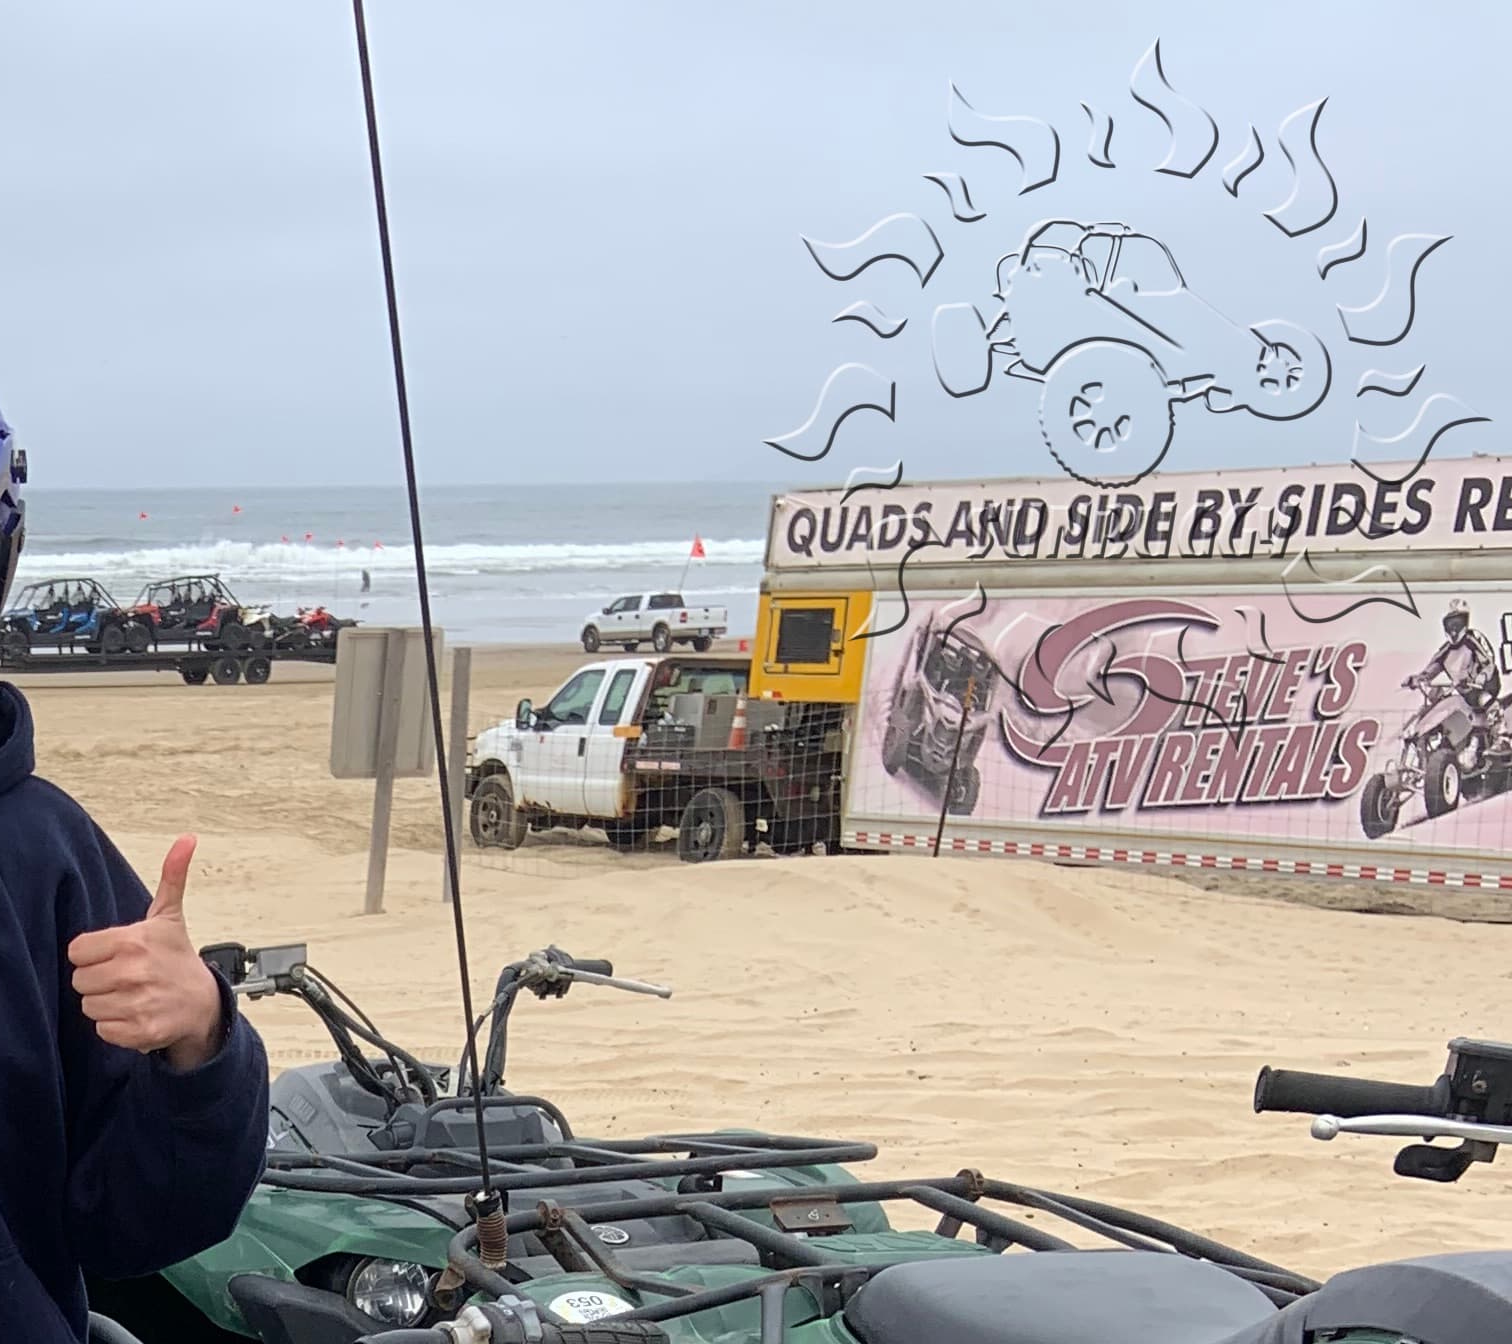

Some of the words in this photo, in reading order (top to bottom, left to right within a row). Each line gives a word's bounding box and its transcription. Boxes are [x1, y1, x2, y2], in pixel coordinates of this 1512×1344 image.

[787, 502, 933, 557] QUADS
[944, 497, 1049, 548] AND
[1063, 491, 1177, 545] SIDE
[1191, 486, 1264, 541] BY
[1273, 478, 1436, 539] SIDES
[1001, 598, 1368, 770] STEVE'S
[1042, 733, 1160, 813] ATV
[1142, 718, 1381, 807] RENTALS
